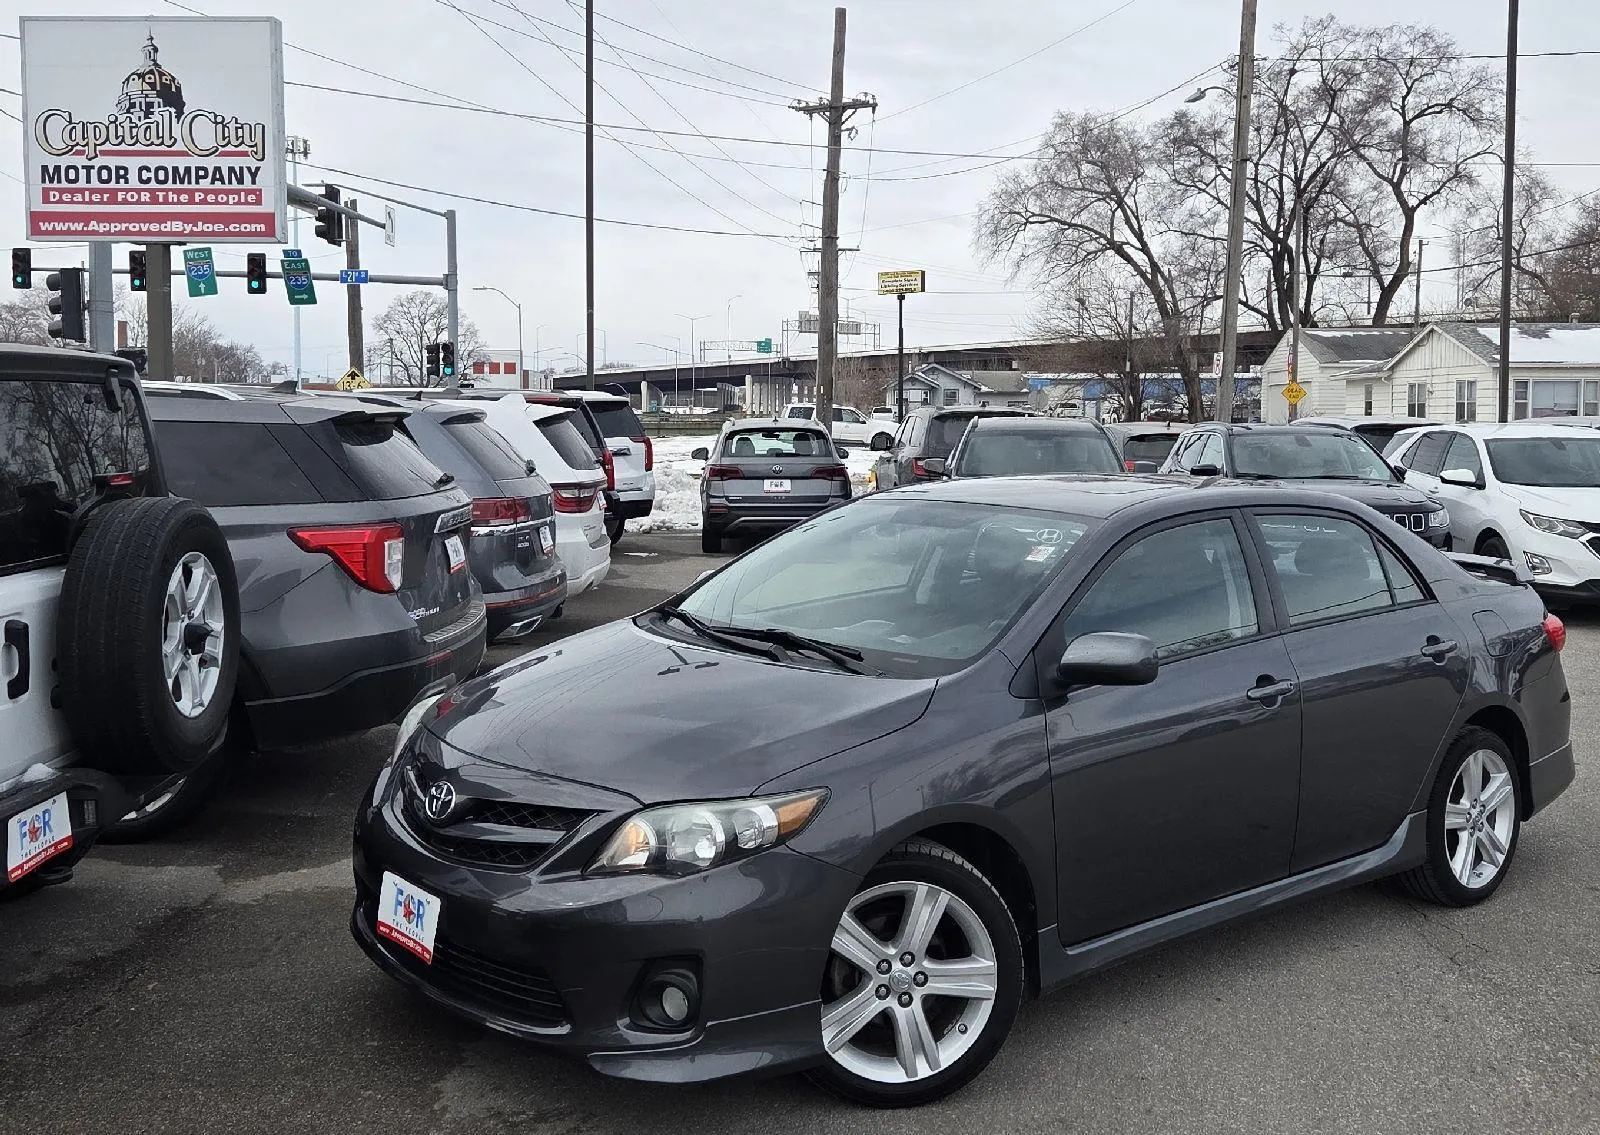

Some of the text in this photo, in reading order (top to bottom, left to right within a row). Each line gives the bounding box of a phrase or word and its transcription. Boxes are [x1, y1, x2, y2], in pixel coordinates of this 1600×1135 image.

[35, 108, 265, 161] Capital City
[41, 164, 262, 185] MOTOR COMPANY
[49, 191, 257, 205] Dealer FOR The People
[38, 220, 266, 234] www.ApprovedByJoe.com
[186, 250, 209, 259] WEST
[190, 264, 210, 276] 235
[283, 261, 306, 269] EAST
[289, 275, 309, 285] 235
